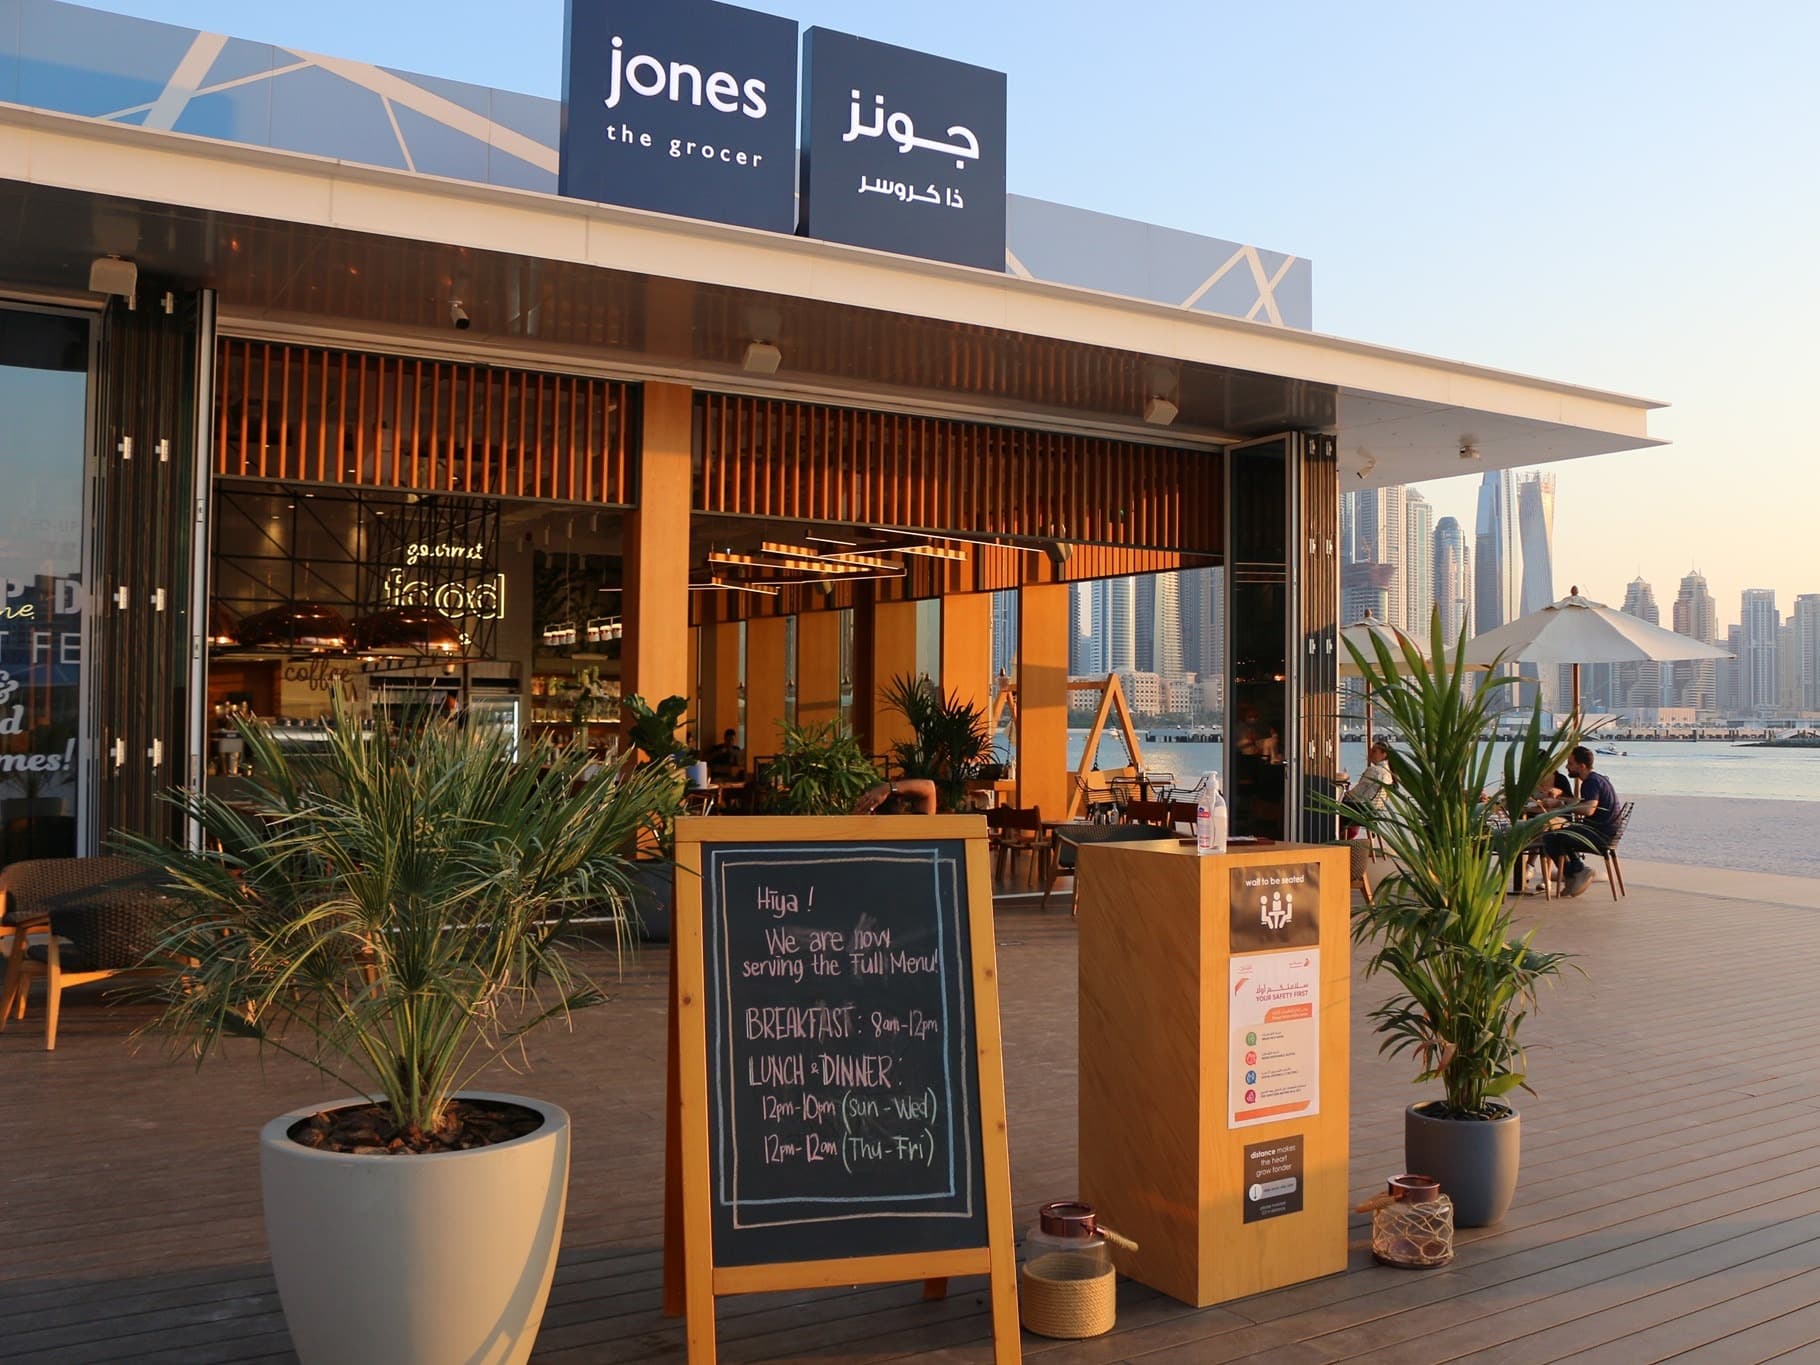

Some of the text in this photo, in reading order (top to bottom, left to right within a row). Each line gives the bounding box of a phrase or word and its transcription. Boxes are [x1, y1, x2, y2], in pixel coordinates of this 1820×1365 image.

[605, 36, 767, 119] jones
[842, 89, 980, 169] جونز
[606, 124, 763, 168] the grocer
[384, 567, 505, 619] food
[285, 657, 353, 691] coffee
[1245, 874, 1305, 888] wait to be seated
[765, 926, 891, 955] We are now
[743, 955, 804, 983] serving
[811, 955, 841, 976] the
[849, 951, 884, 975] Full
[1272, 992, 1293, 1000] SAFETY
[1294, 990, 1309, 998] FIRST
[749, 1055, 805, 1086] LUNCH
[1250, 1145, 1296, 1160] distance makes
[1271, 1155, 1288, 1164] heart
[1256, 1168, 1271, 1178] grow
